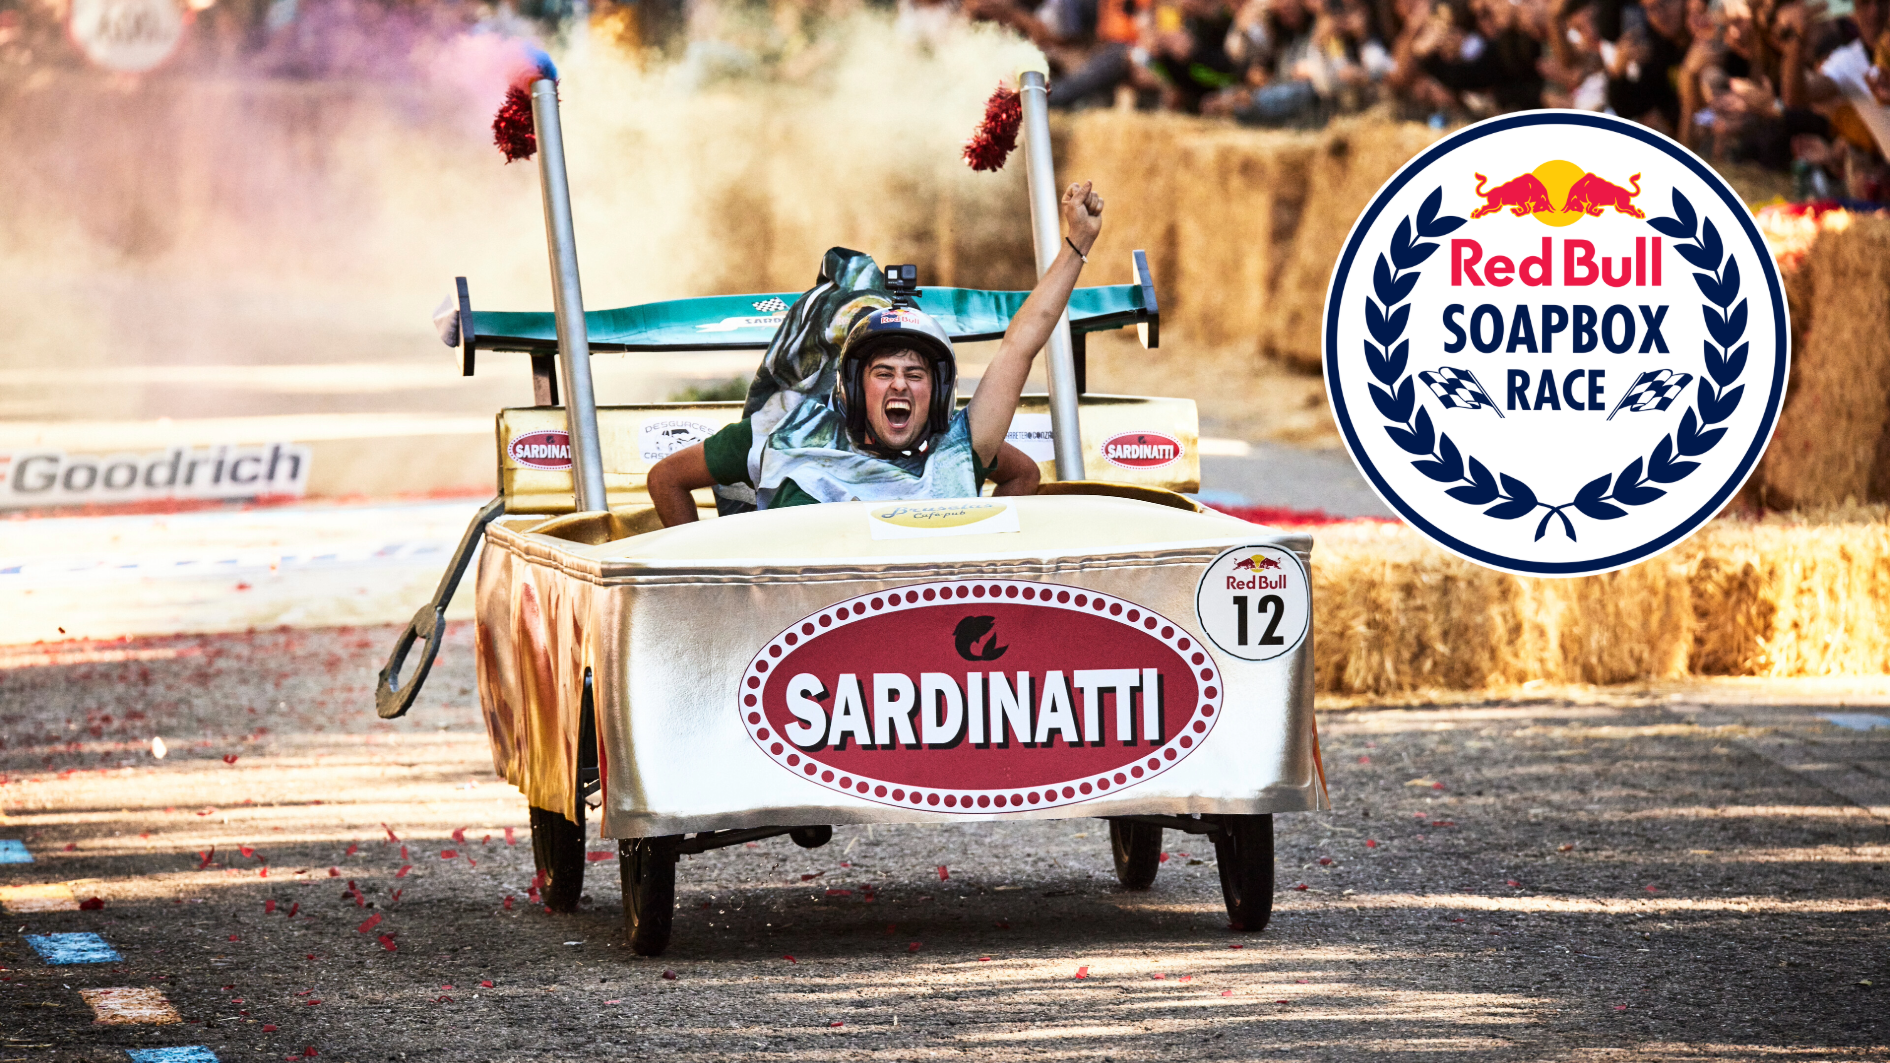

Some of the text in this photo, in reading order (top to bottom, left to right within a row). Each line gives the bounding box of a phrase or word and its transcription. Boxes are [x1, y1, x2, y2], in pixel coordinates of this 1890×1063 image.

[881, 315, 920, 325] Red Bull
[645, 420, 714, 436] DESGUACES
[1107, 444, 1174, 460] SARDINATTI
[1226, 574, 1287, 590] Red Bull
[1232, 594, 1285, 646] 12
[784, 667, 1164, 752] SARDINATTI
